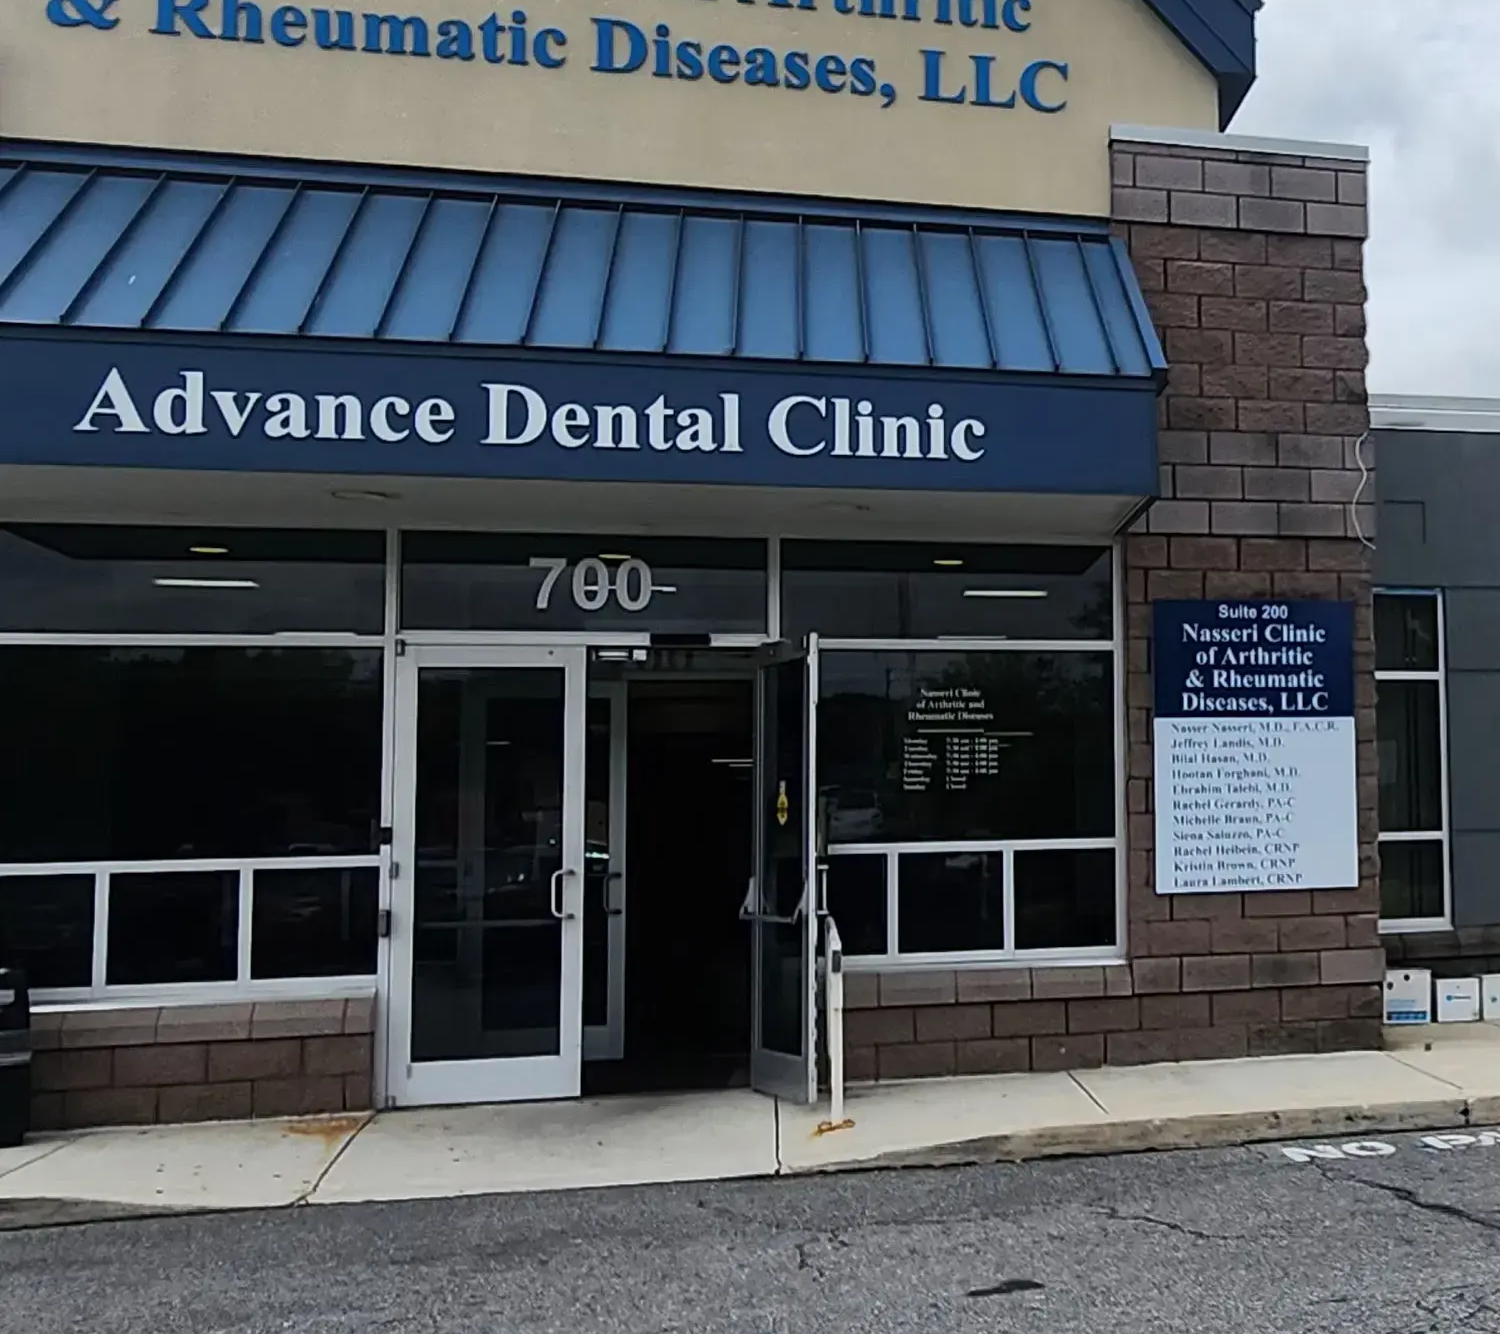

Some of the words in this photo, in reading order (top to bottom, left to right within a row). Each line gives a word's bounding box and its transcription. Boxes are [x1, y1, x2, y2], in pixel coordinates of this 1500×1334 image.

[591, 15, 897, 107] Diseases,
[921, 47, 1071, 113] LLC
[73, 367, 455, 443] Advance
[480, 383, 743, 453] Dental
[768, 395, 986, 461] Clinic
[528, 557, 654, 611] 700
[1218, 604, 1257, 619] Suite
[1261, 605, 1288, 619] 200
[1182, 623, 1258, 642] Nasseri
[1264, 624, 1326, 643] Clinic
[1196, 646, 1218, 665] of
[1221, 646, 1313, 665] Arthritic
[1185, 669, 1204, 688] &
[1212, 669, 1324, 688] Rheumatic
[1181, 692, 1274, 713] Diseases,
[1280, 691, 1329, 711] LLC
[1170, 738, 1209, 752] Jeffrey
[1171, 753, 1198, 764] Bilal
[1173, 800, 1211, 811] Rachel
[1173, 815, 1221, 826] Michelle
[1174, 846, 1212, 857] Rachel
[1264, 842, 1300, 855] CRNP
[1260, 857, 1296, 870] CRNP
[1174, 877, 1208, 888] Laura
[1266, 873, 1303, 885] CRNP
[1281, 1140, 1396, 1162] NO
